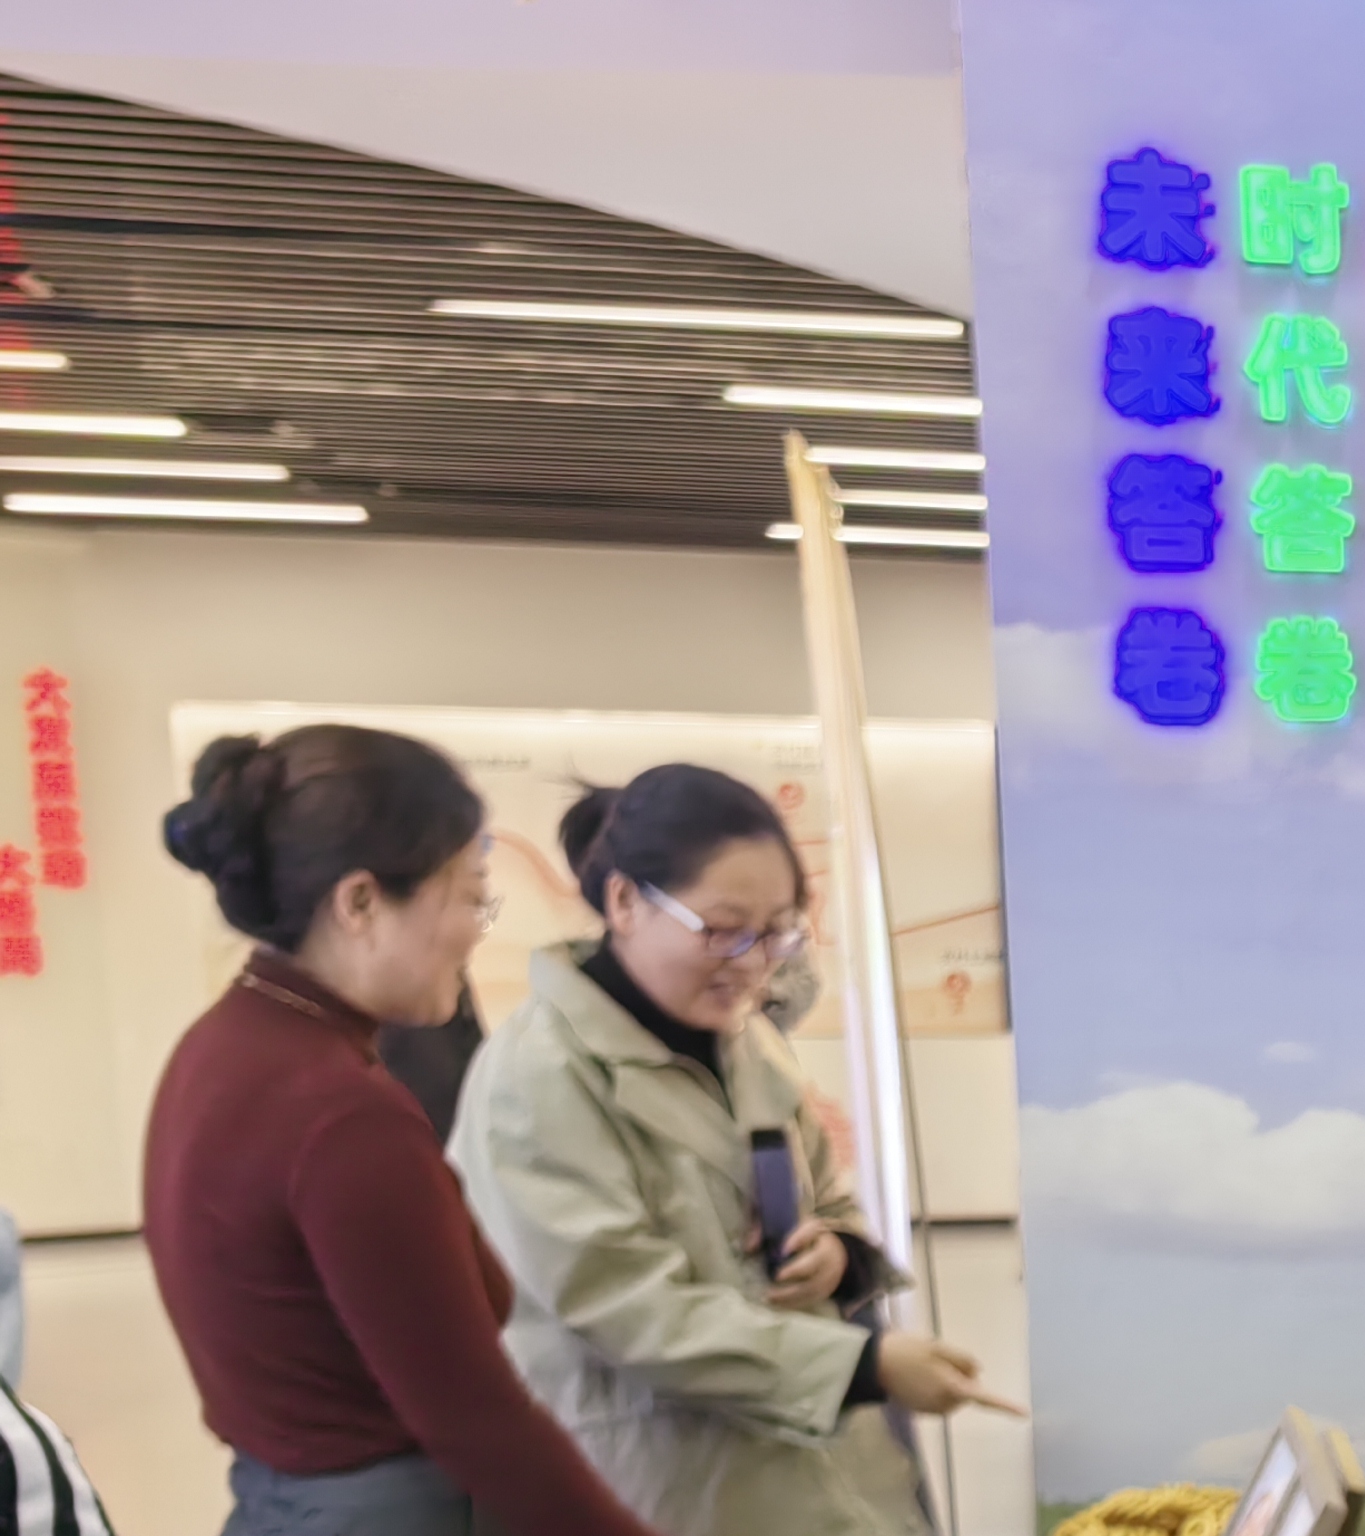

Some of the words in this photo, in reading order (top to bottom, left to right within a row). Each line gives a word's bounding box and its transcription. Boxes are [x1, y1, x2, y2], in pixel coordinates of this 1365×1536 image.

[1098, 147, 1226, 726] 未来答卷
[1239, 163, 1358, 723] 时代答卷
